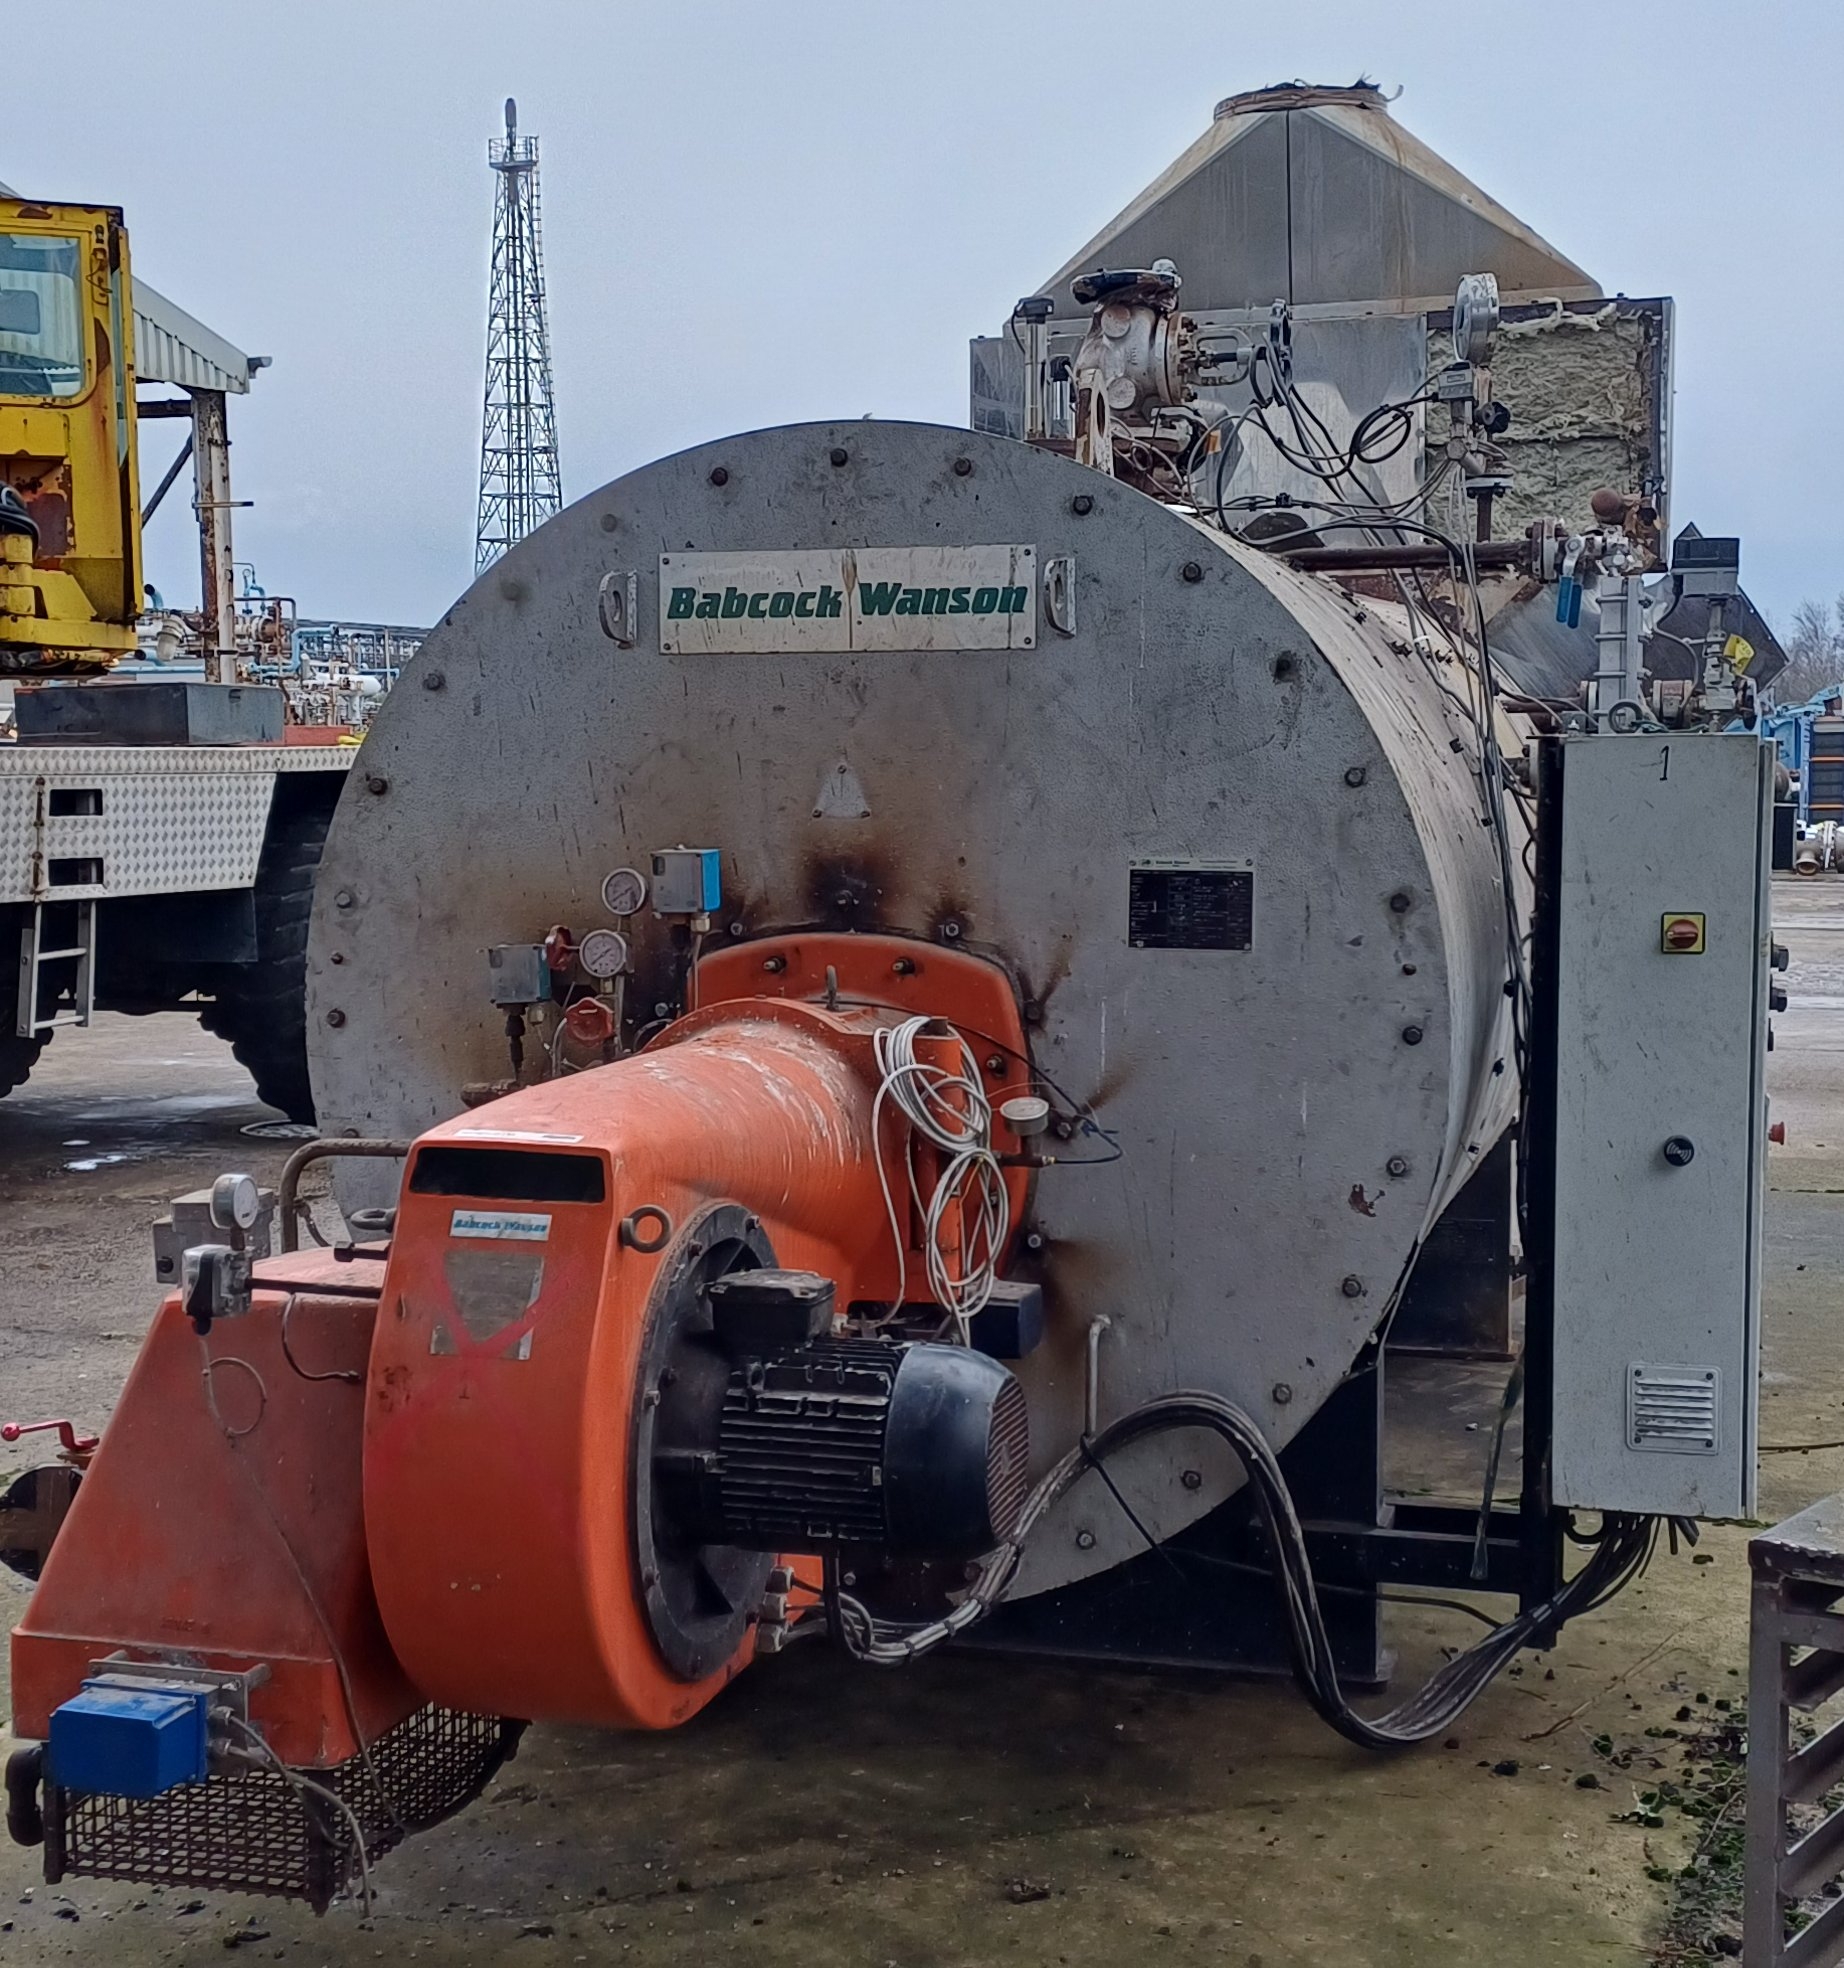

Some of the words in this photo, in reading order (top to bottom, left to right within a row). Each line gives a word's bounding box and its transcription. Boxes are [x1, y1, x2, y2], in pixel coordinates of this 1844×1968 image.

[667, 585, 843, 619] Babcock
[858, 582, 1028, 615] Wanson
[1660, 745, 1669, 781] 1
